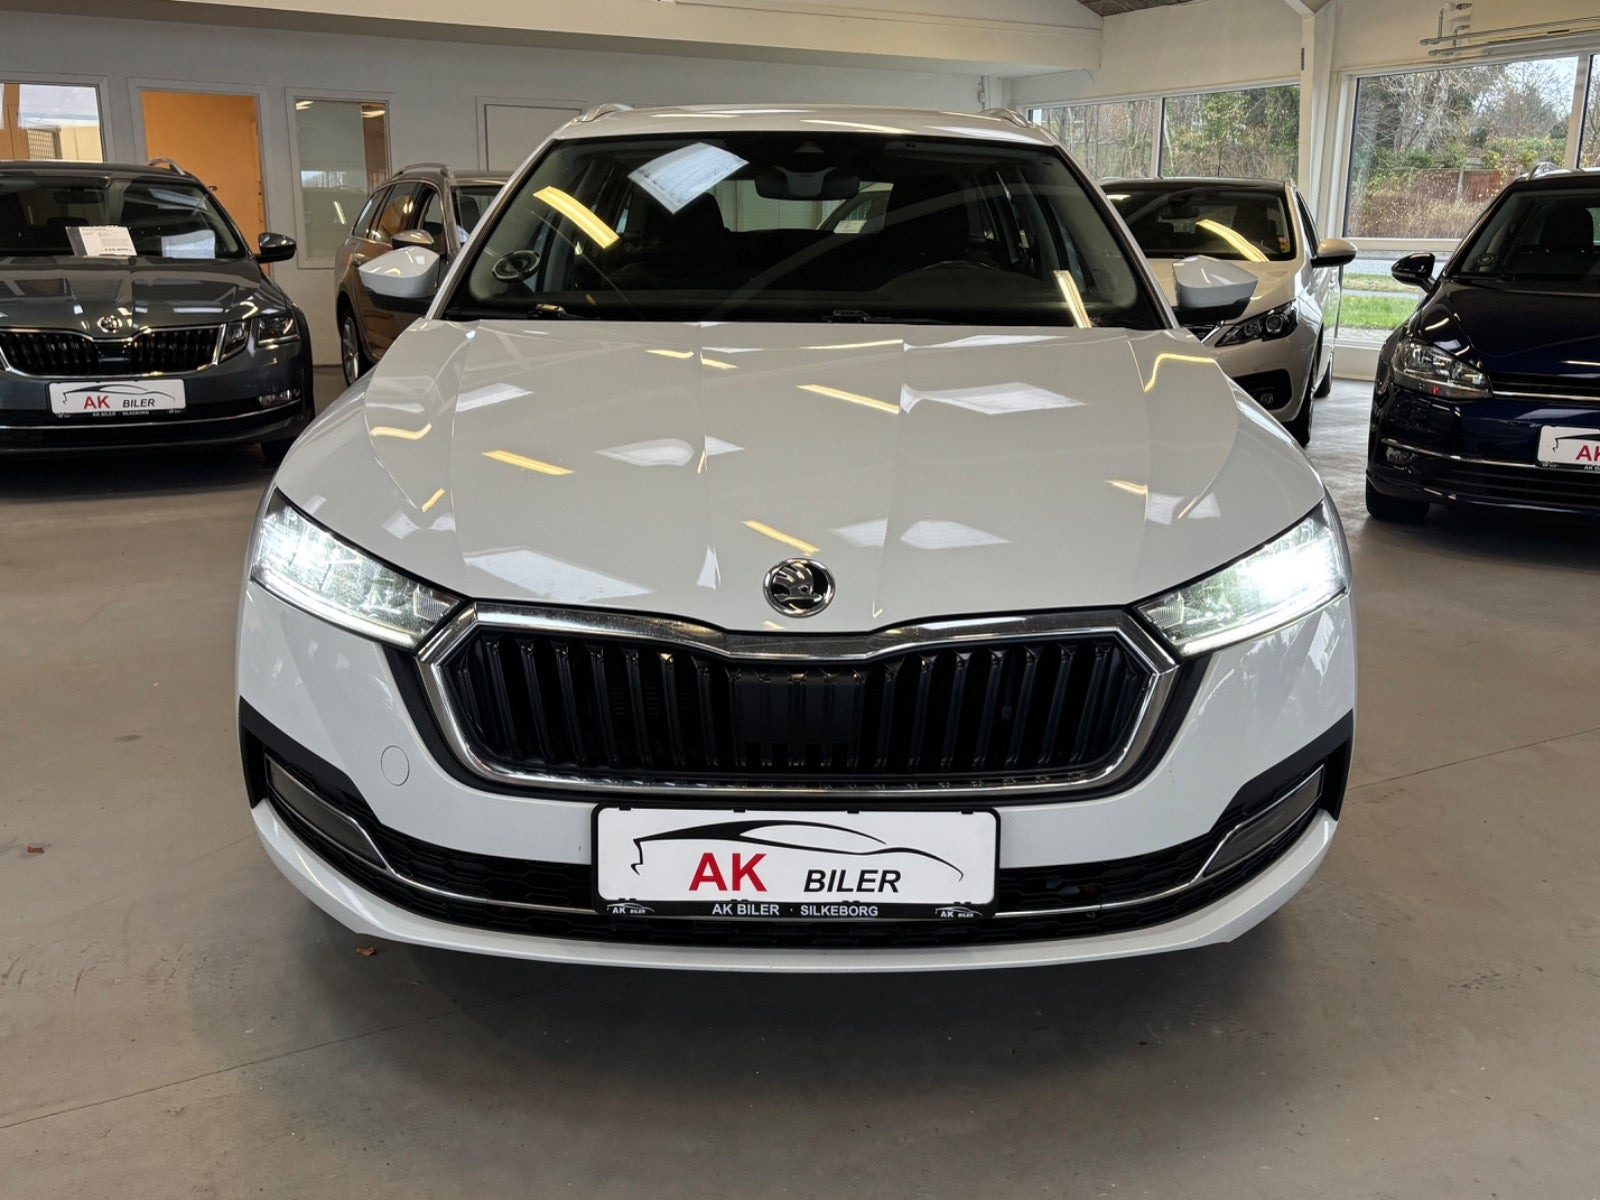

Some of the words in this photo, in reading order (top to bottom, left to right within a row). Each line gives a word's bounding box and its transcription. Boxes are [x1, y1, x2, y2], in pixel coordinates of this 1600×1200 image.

[83, 395, 110, 410] AK
[122, 399, 155, 409] BILER
[688, 852, 768, 892] AK
[803, 869, 902, 893] BILER
[612, 906, 626, 914] AK
[711, 903, 733, 915] AK
[736, 903, 780, 915] BILER
[800, 905, 879, 917] SILKEBORG
[940, 910, 954, 918] AK
